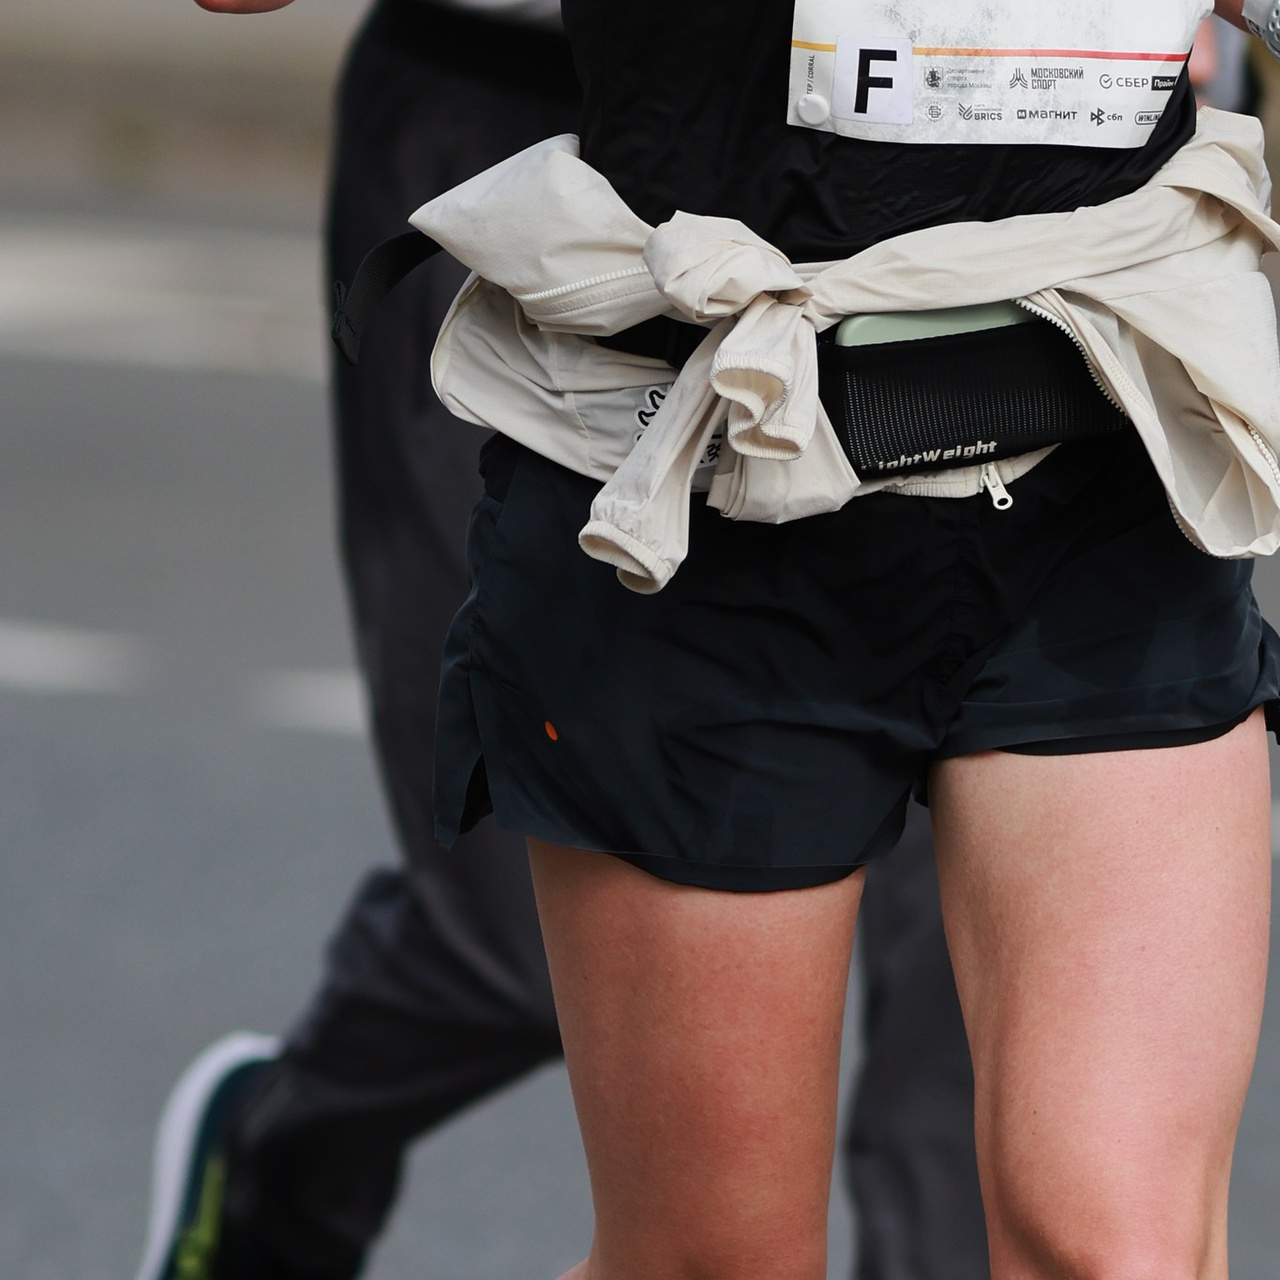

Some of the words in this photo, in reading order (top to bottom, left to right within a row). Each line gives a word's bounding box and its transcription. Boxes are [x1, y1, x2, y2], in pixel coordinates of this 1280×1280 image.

[807, 55, 815, 79] CORRAL
[1031, 67, 1084, 80] МОСКОВСКИЙ
[854, 48, 897, 114] F
[1032, 79, 1057, 90] СПОРТ
[1116, 77, 1149, 88] СБЕР
[974, 113, 1003, 121] BRICS
[1029, 110, 1078, 120] магнит
[1107, 113, 1123, 121] сбп
